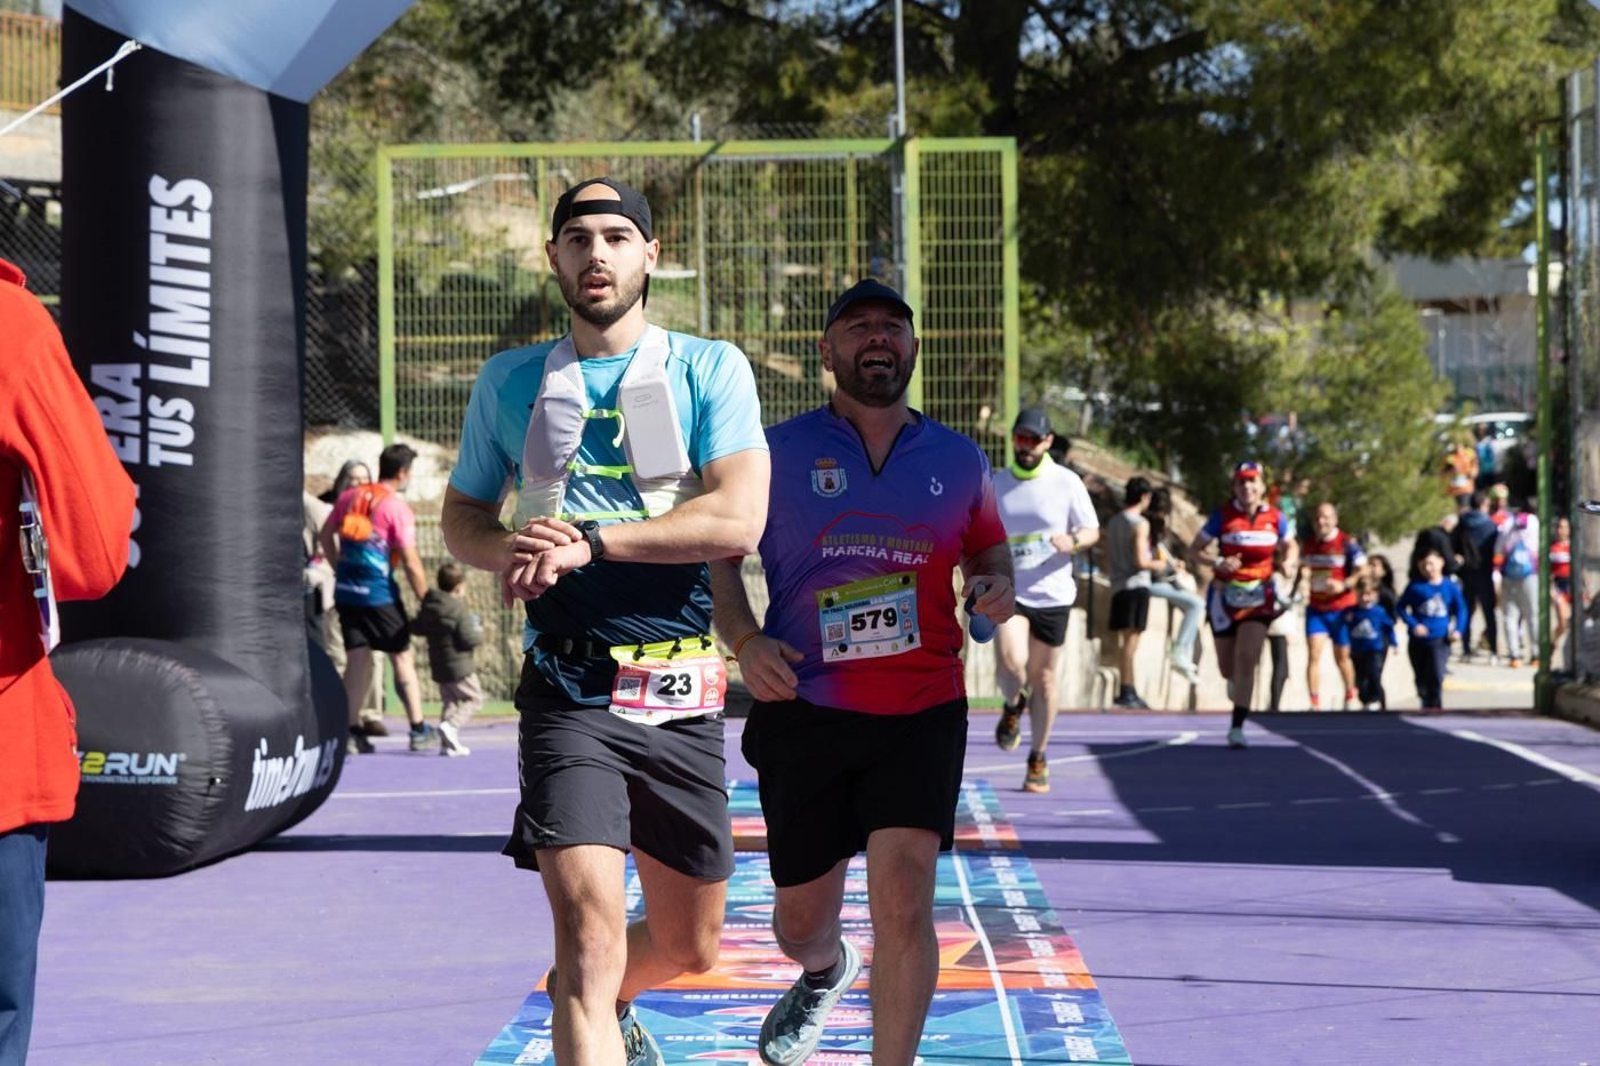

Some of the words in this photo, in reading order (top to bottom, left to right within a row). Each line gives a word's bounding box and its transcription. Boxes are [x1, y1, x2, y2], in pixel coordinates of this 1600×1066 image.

[133, 173, 213, 388] LÍMITES
[147, 394, 195, 467] TUS
[91, 363, 141, 568] ERA
[822, 545, 889, 560] MANCHA
[892, 550, 930, 566] REAL
[851, 606, 898, 632] 579
[656, 672, 692, 696] 23
[79, 750, 178, 775] 2RUN
